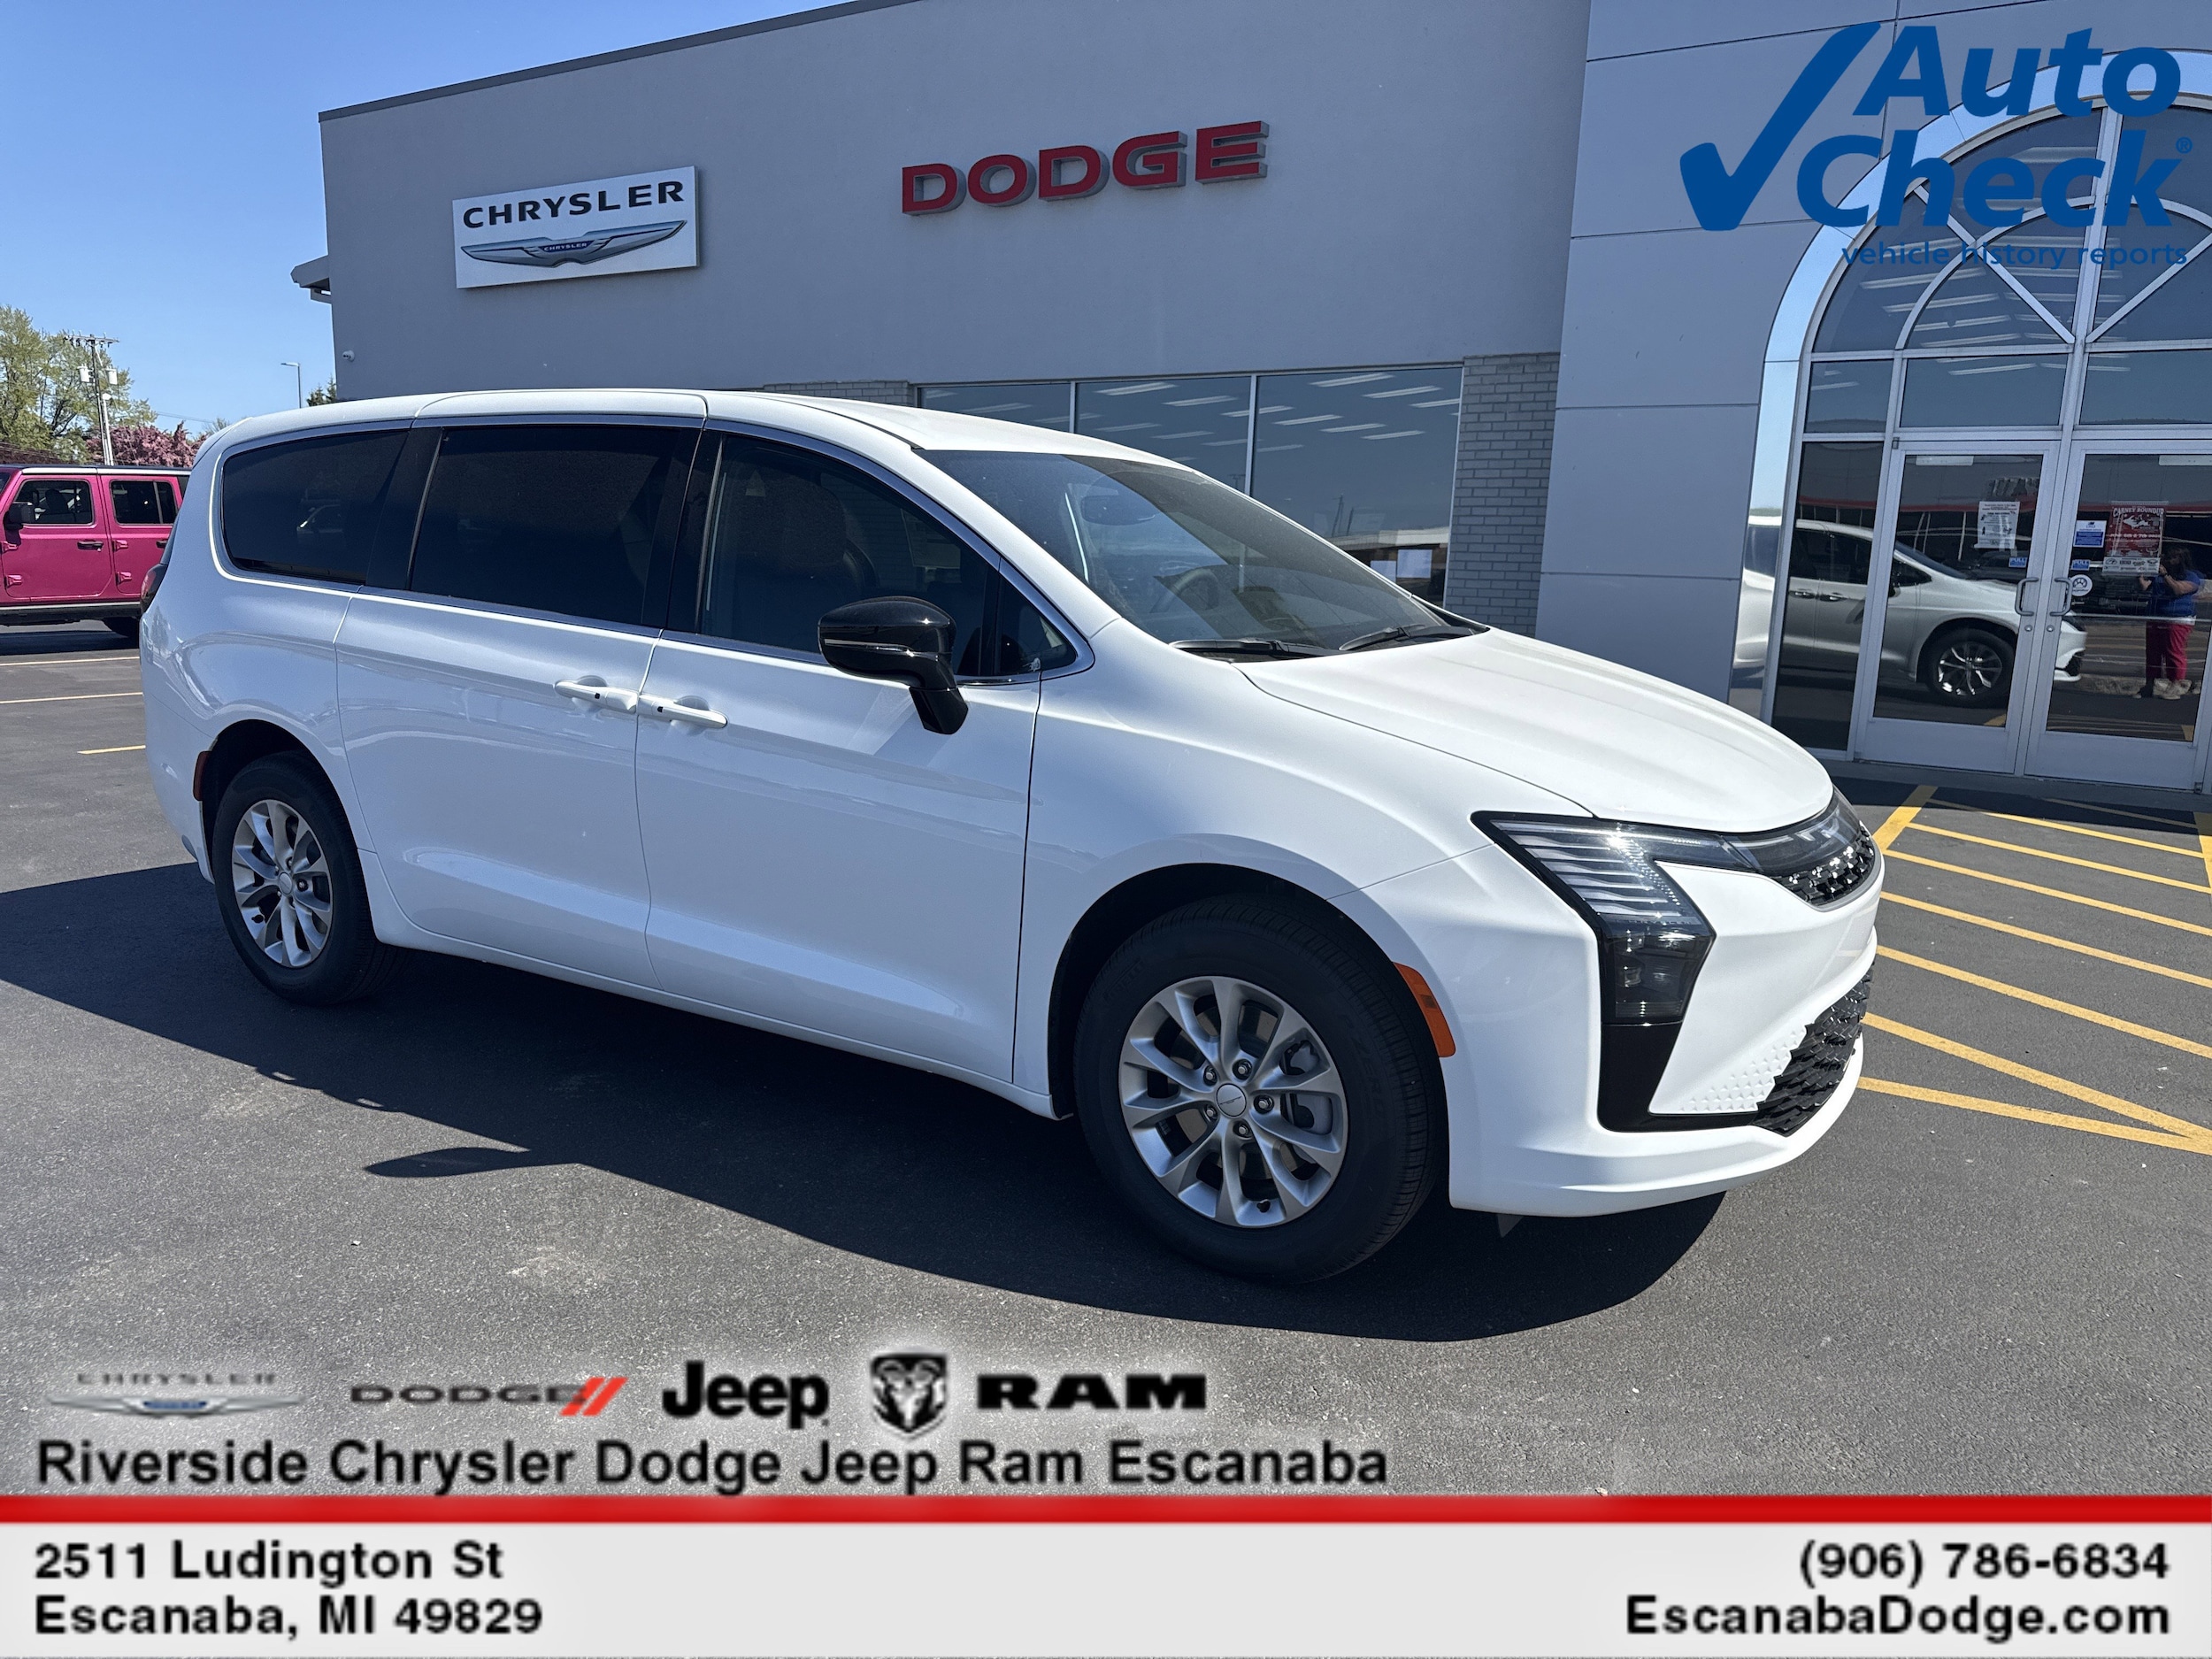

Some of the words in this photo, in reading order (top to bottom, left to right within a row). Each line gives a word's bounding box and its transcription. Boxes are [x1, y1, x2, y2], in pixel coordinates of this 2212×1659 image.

[902, 120, 1268, 216] DODGE
[463, 180, 684, 228] CHRYSLER
[543, 242, 588, 251] CHRYSLER
